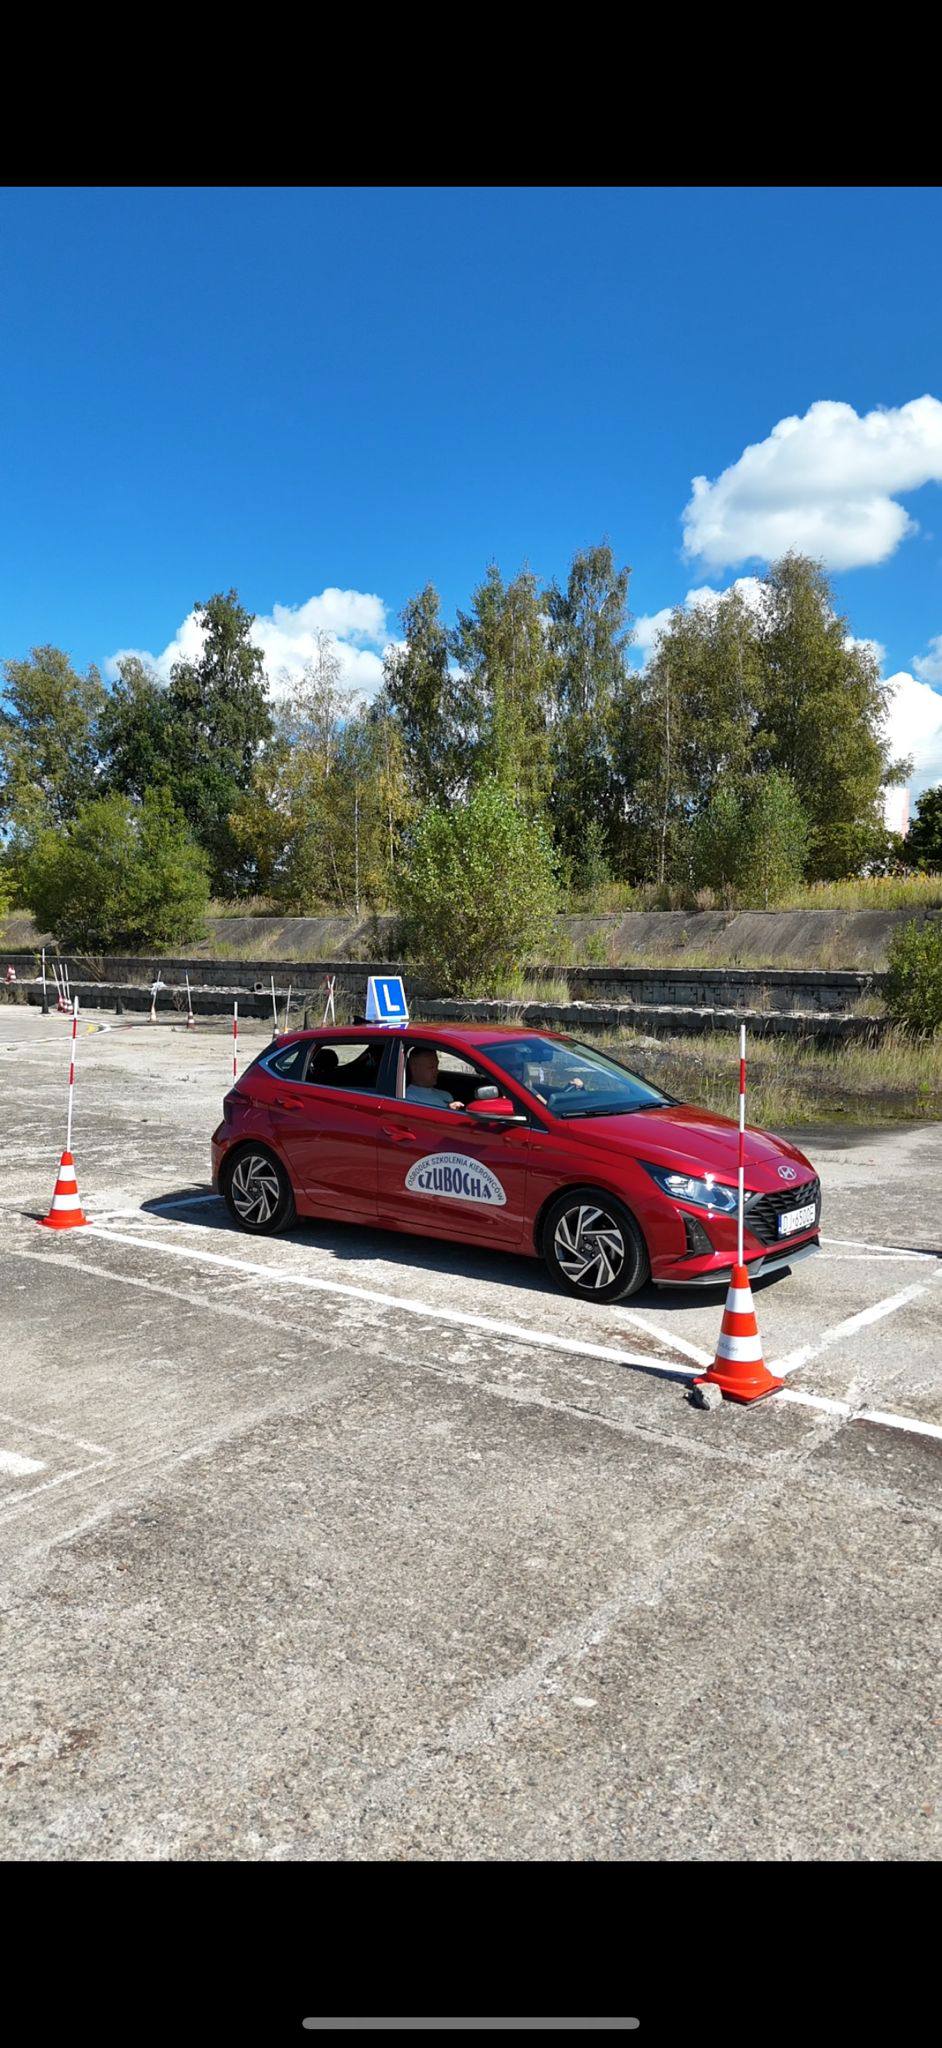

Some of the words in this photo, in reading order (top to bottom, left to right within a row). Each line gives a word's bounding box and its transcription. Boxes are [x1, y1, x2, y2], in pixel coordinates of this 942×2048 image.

[382, 984, 400, 1012] L
[417, 1166, 492, 1200] CZUBOCHA
[431, 1155, 468, 1167] SZKOLENIA
[468, 1162, 504, 1201] KIEROWCÓW
